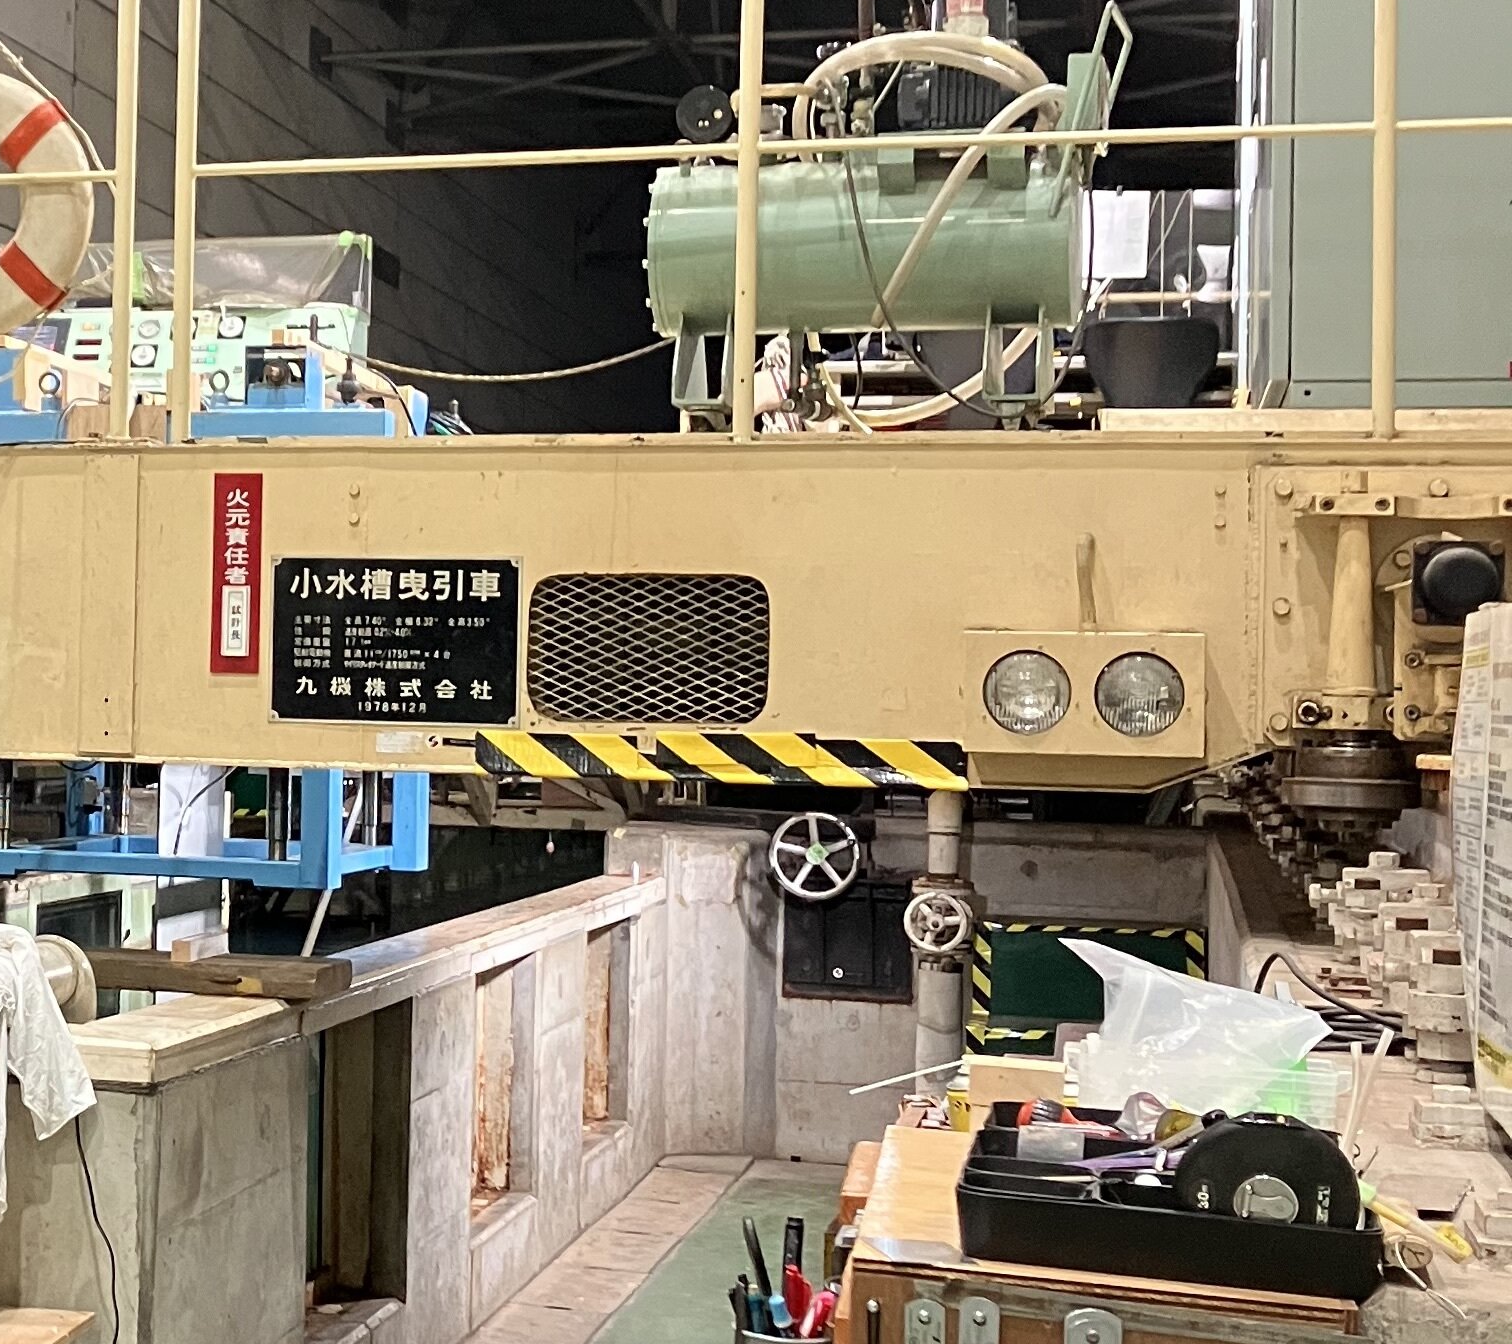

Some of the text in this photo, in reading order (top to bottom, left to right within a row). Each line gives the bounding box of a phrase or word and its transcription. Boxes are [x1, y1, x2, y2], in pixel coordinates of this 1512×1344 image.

[224, 488, 250, 585] 火元責任者
[289, 567, 501, 601] 小水槽曳引車
[295, 675, 493, 700] 九機株式会社
[357, 701, 427, 713] 1978年12月
